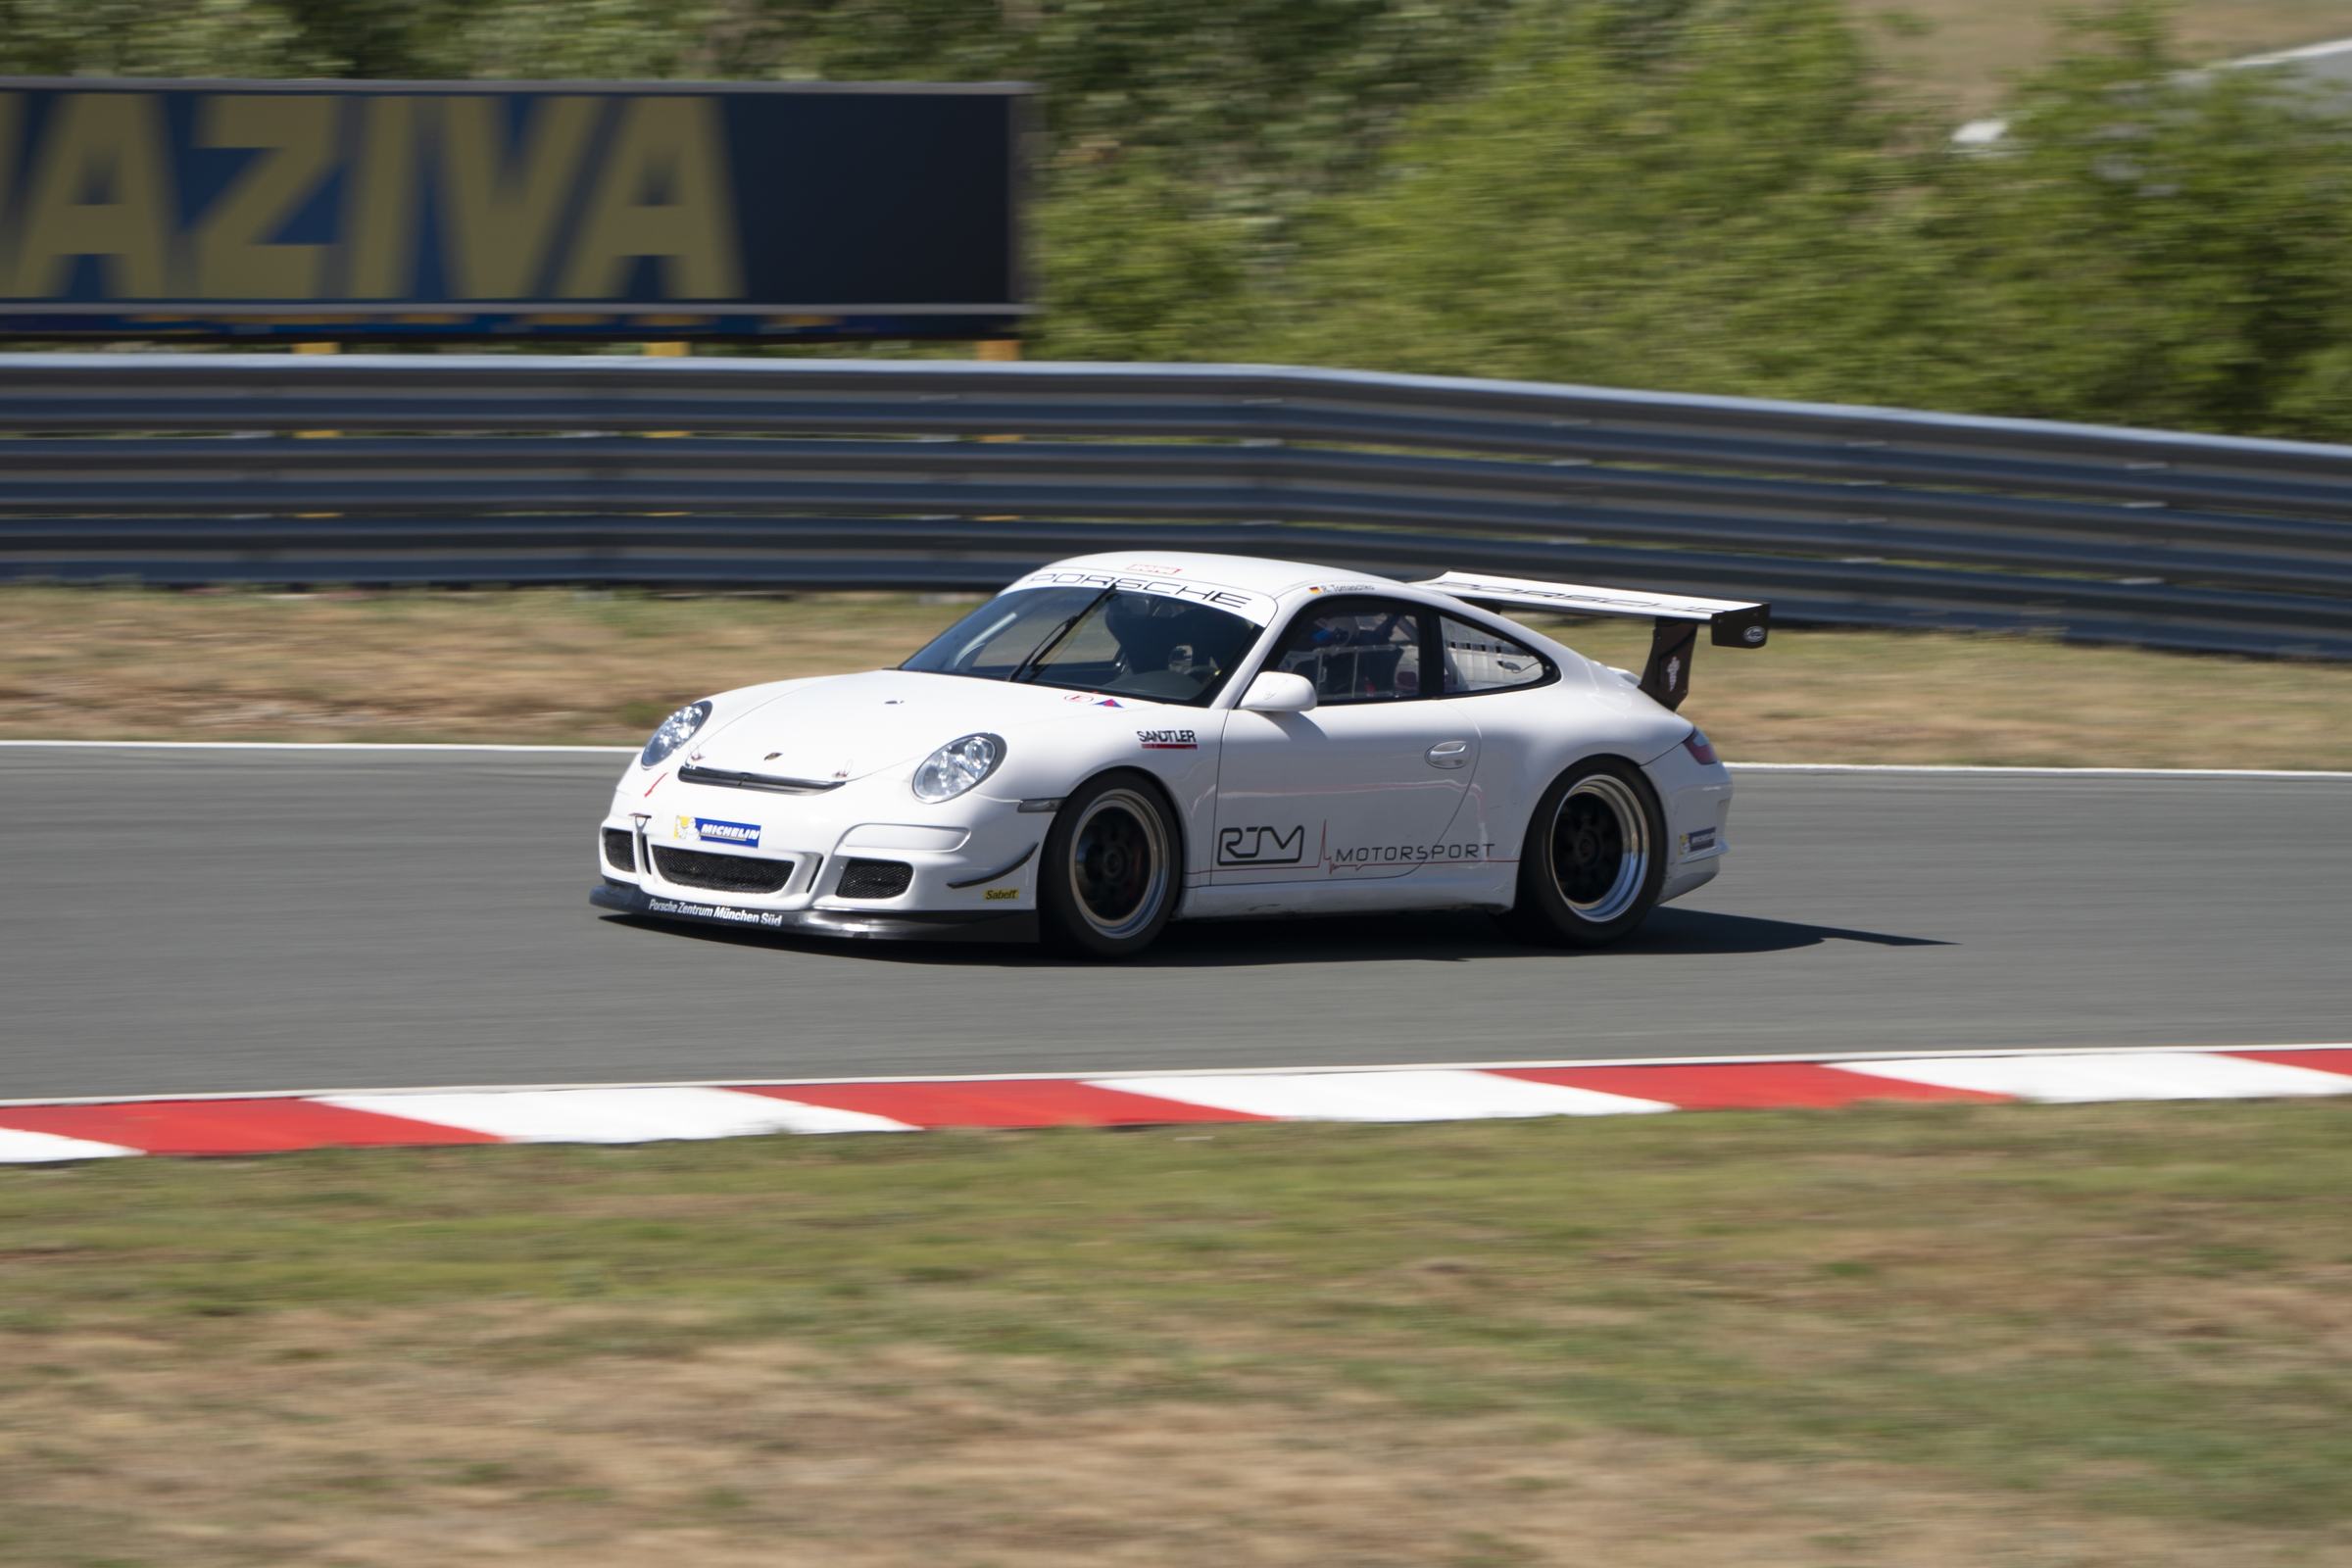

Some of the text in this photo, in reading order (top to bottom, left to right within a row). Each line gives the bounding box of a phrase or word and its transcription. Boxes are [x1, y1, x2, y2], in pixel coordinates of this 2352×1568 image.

[0, 95, 747, 299] AZIVA
[1030, 573, 1251, 608] PORSCHE
[1137, 730, 1197, 743] SANDTLER
[701, 823, 760, 840] MICHELIN
[1336, 843, 1495, 862] MOTORSPORT
[649, 899, 783, 927] Porsche Zentrum München Süd
